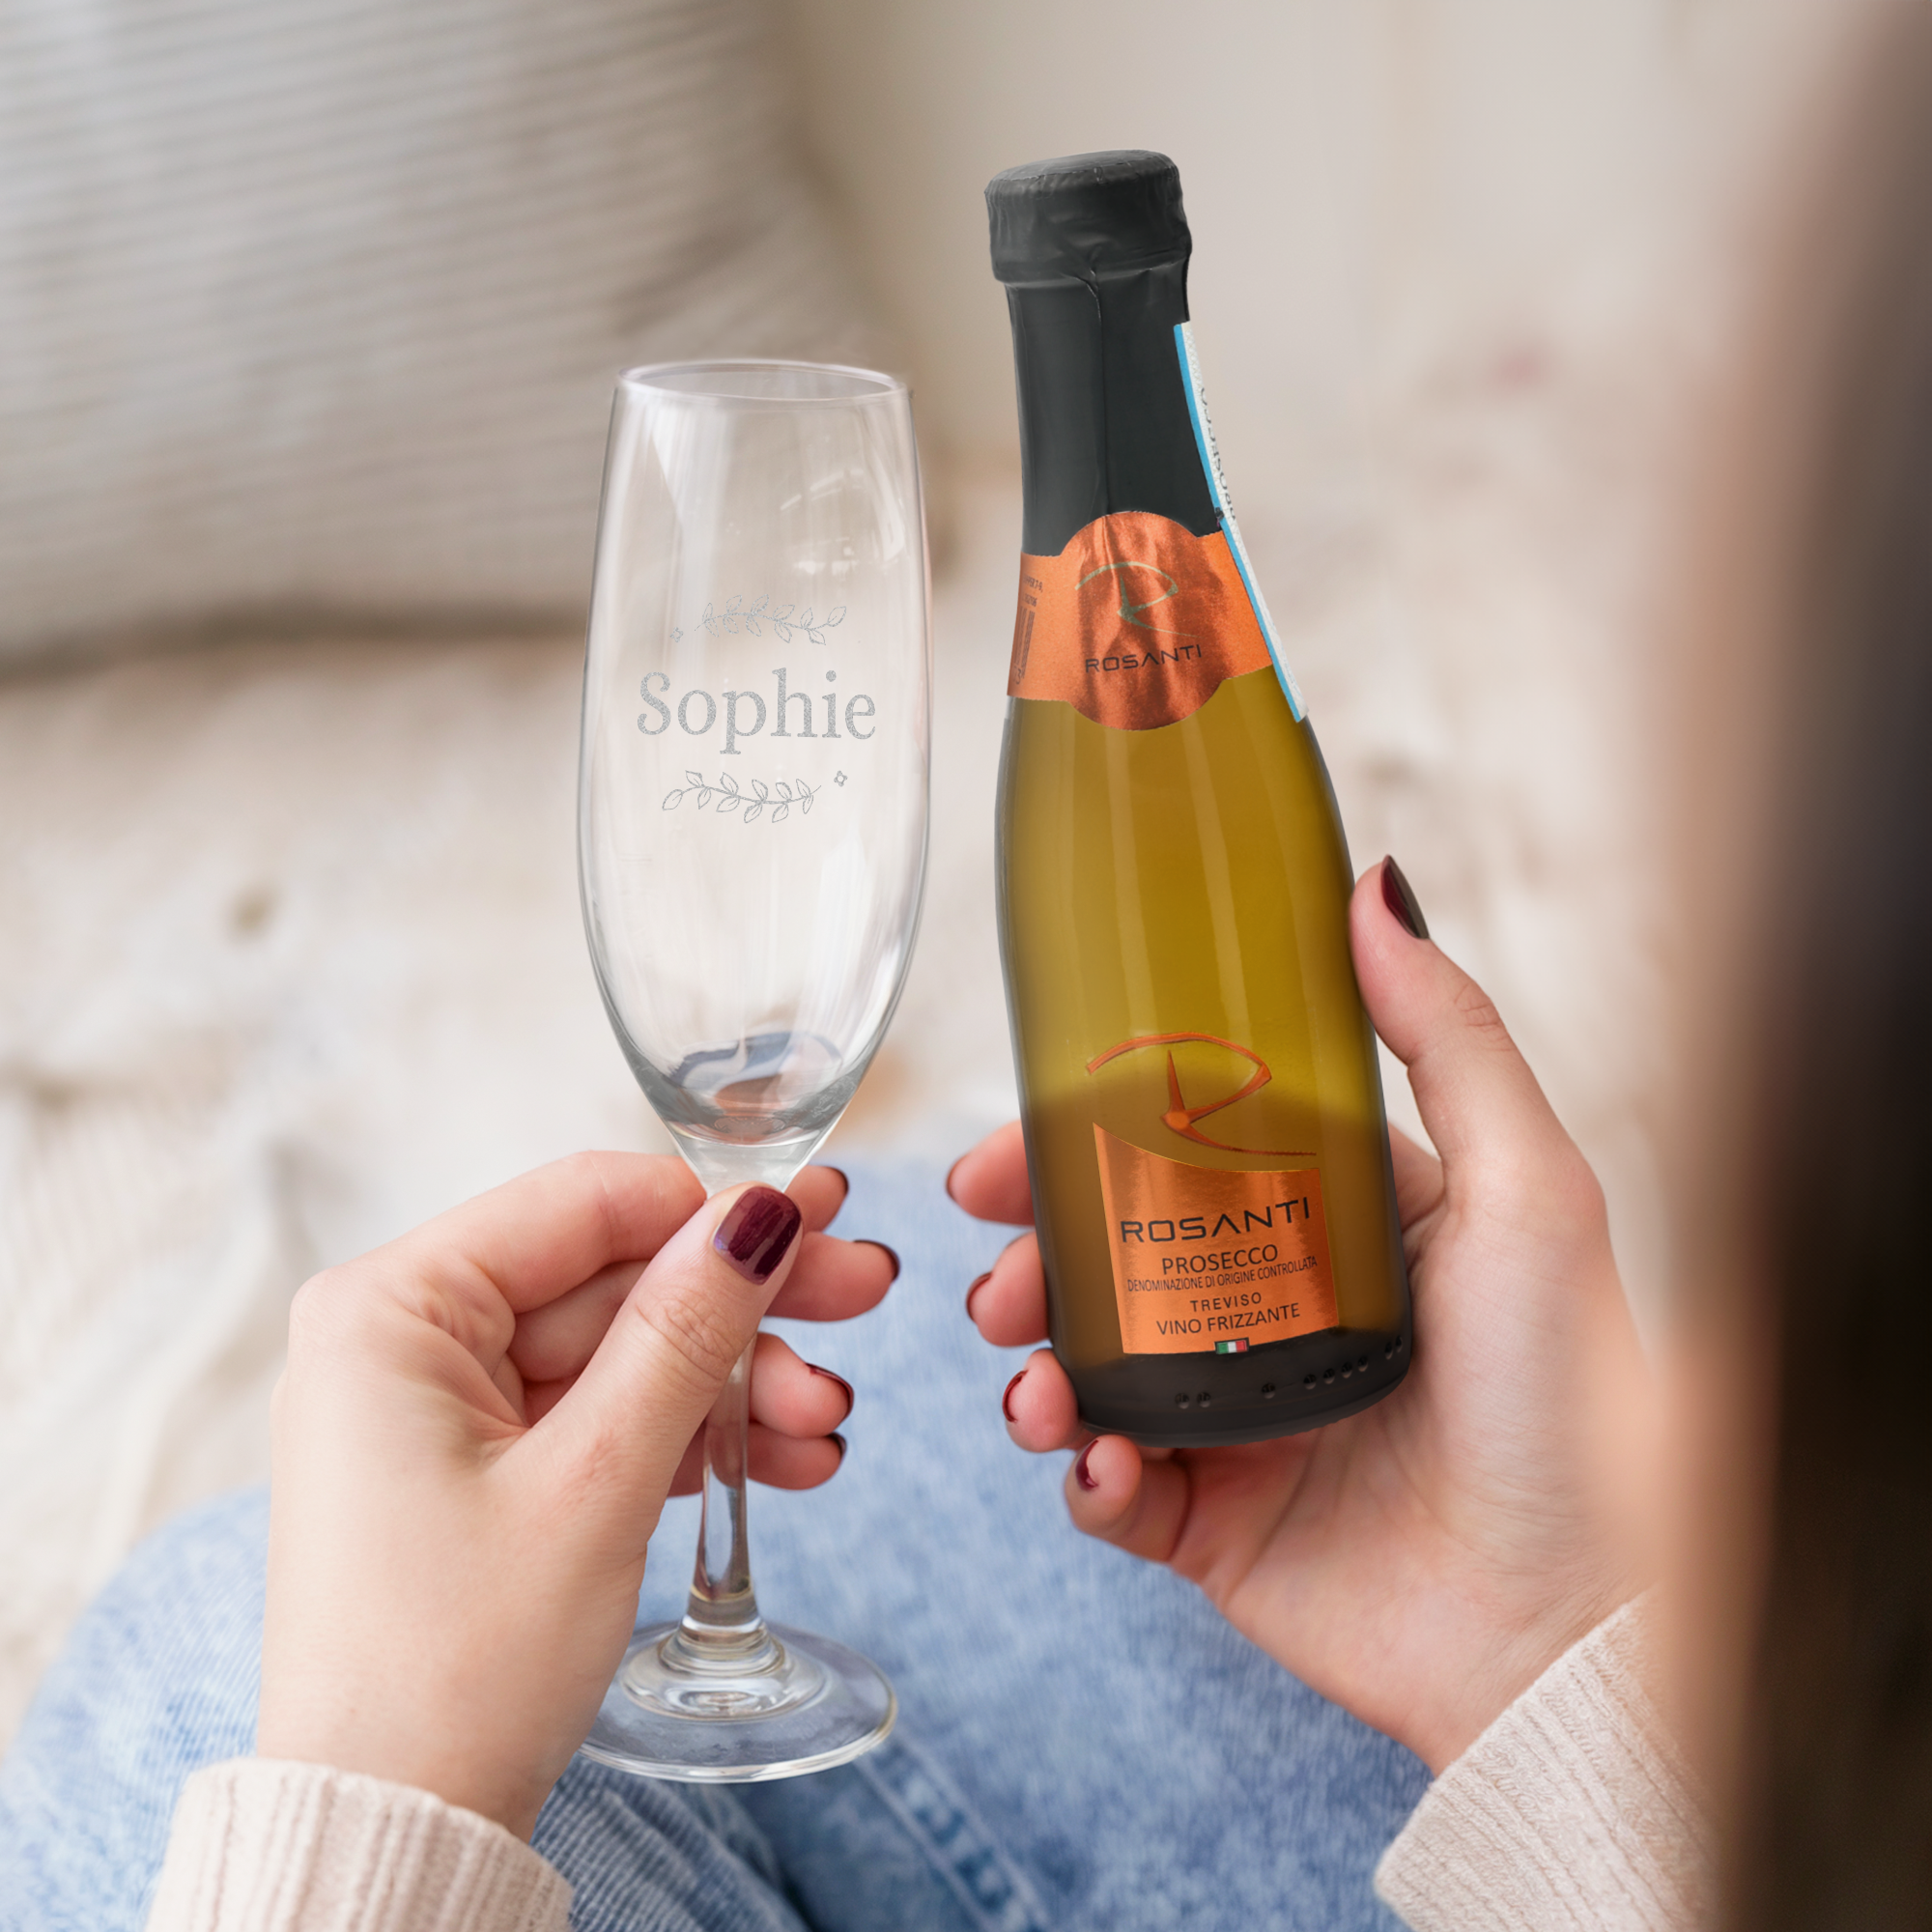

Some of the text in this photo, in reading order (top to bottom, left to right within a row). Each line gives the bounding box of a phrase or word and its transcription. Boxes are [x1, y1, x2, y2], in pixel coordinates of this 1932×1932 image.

[1085, 644, 1203, 673] ROSANTI
[637, 667, 877, 755] Sophie
[1120, 1197, 1310, 1243] ROSANTI
[1127, 1256, 1318, 1293] DENOMINAZIONE DI ORIGINE CONTROLLATA
[1162, 1244, 1278, 1275] PROSECCO
[1156, 1302, 1301, 1336] VINO FRIZZANTE
[1189, 1292, 1263, 1313] TREVISO
